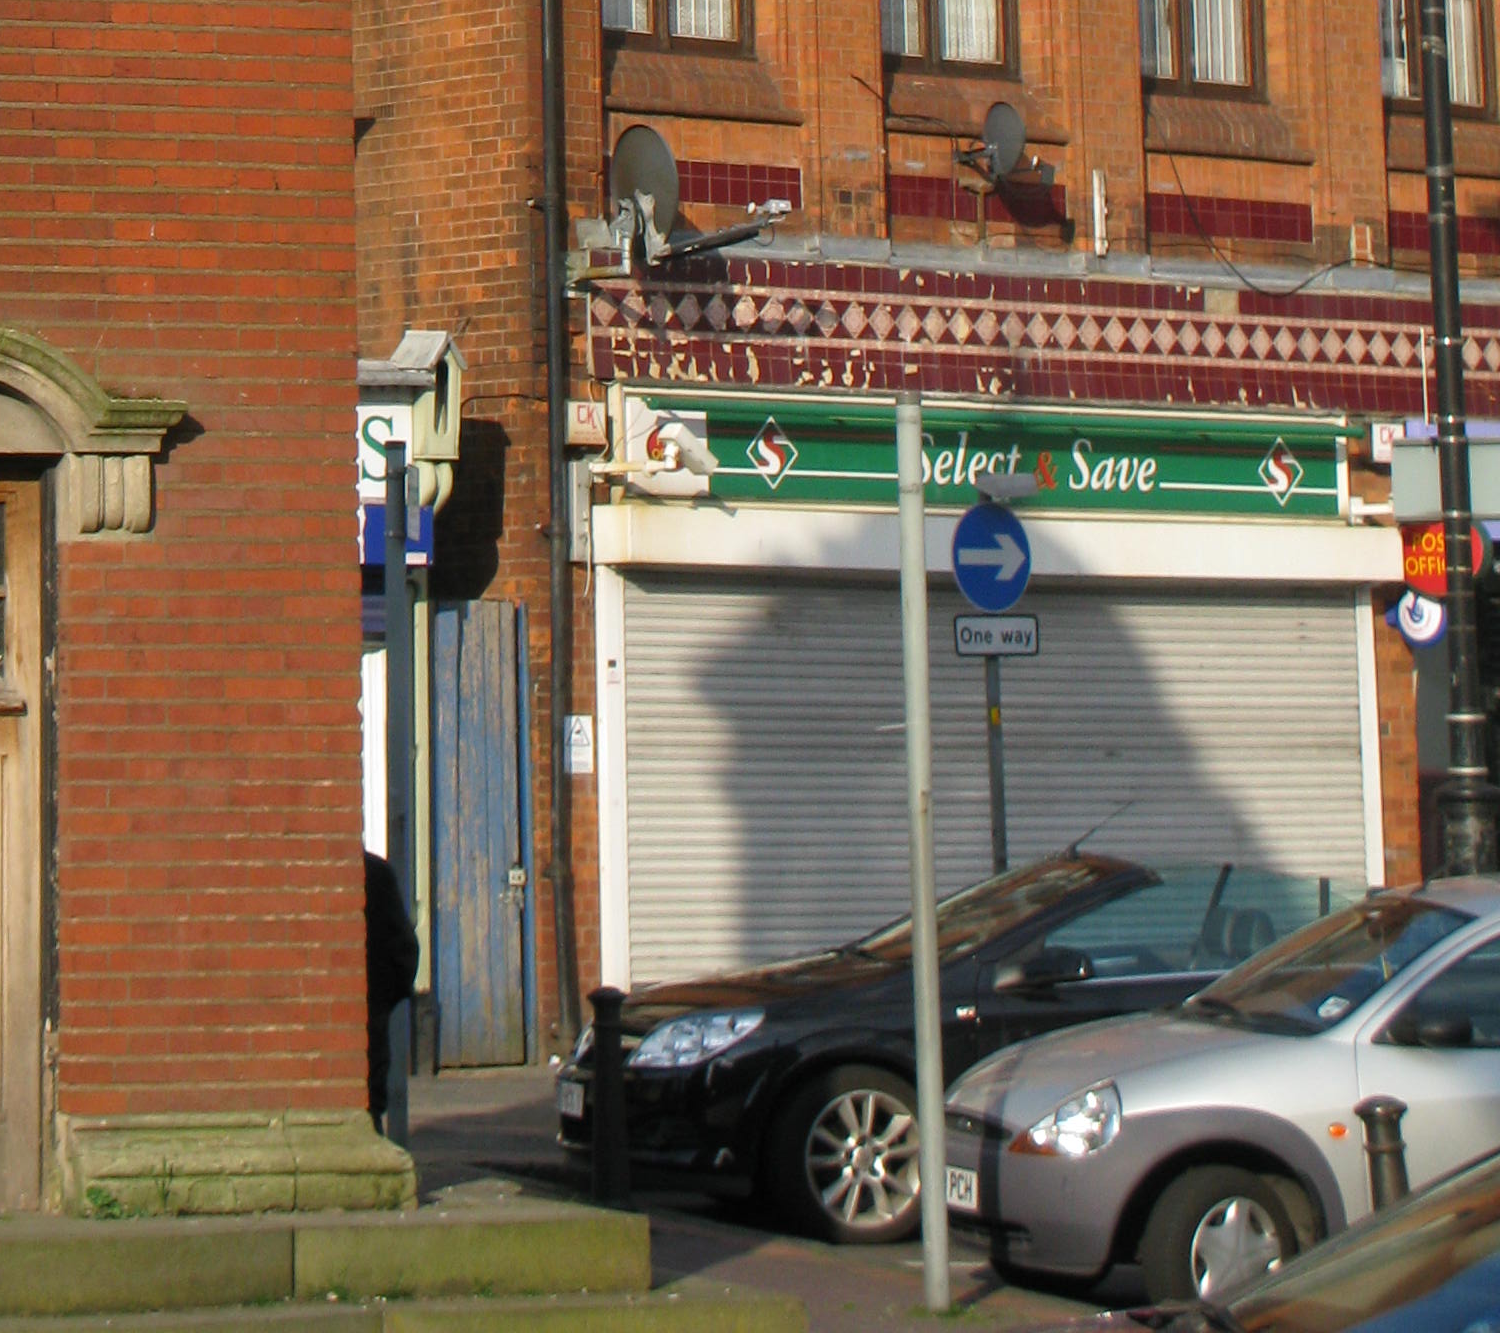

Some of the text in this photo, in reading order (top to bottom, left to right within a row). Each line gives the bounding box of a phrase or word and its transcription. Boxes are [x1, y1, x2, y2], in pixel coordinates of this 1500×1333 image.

[576, 404, 597, 429] CK
[1033, 451, 1058, 489] &
[1069, 438, 1158, 493] Save
[1412, 532, 1445, 552] POS
[1405, 556, 1446, 575] OFFI
[960, 626, 1032, 647] One way
